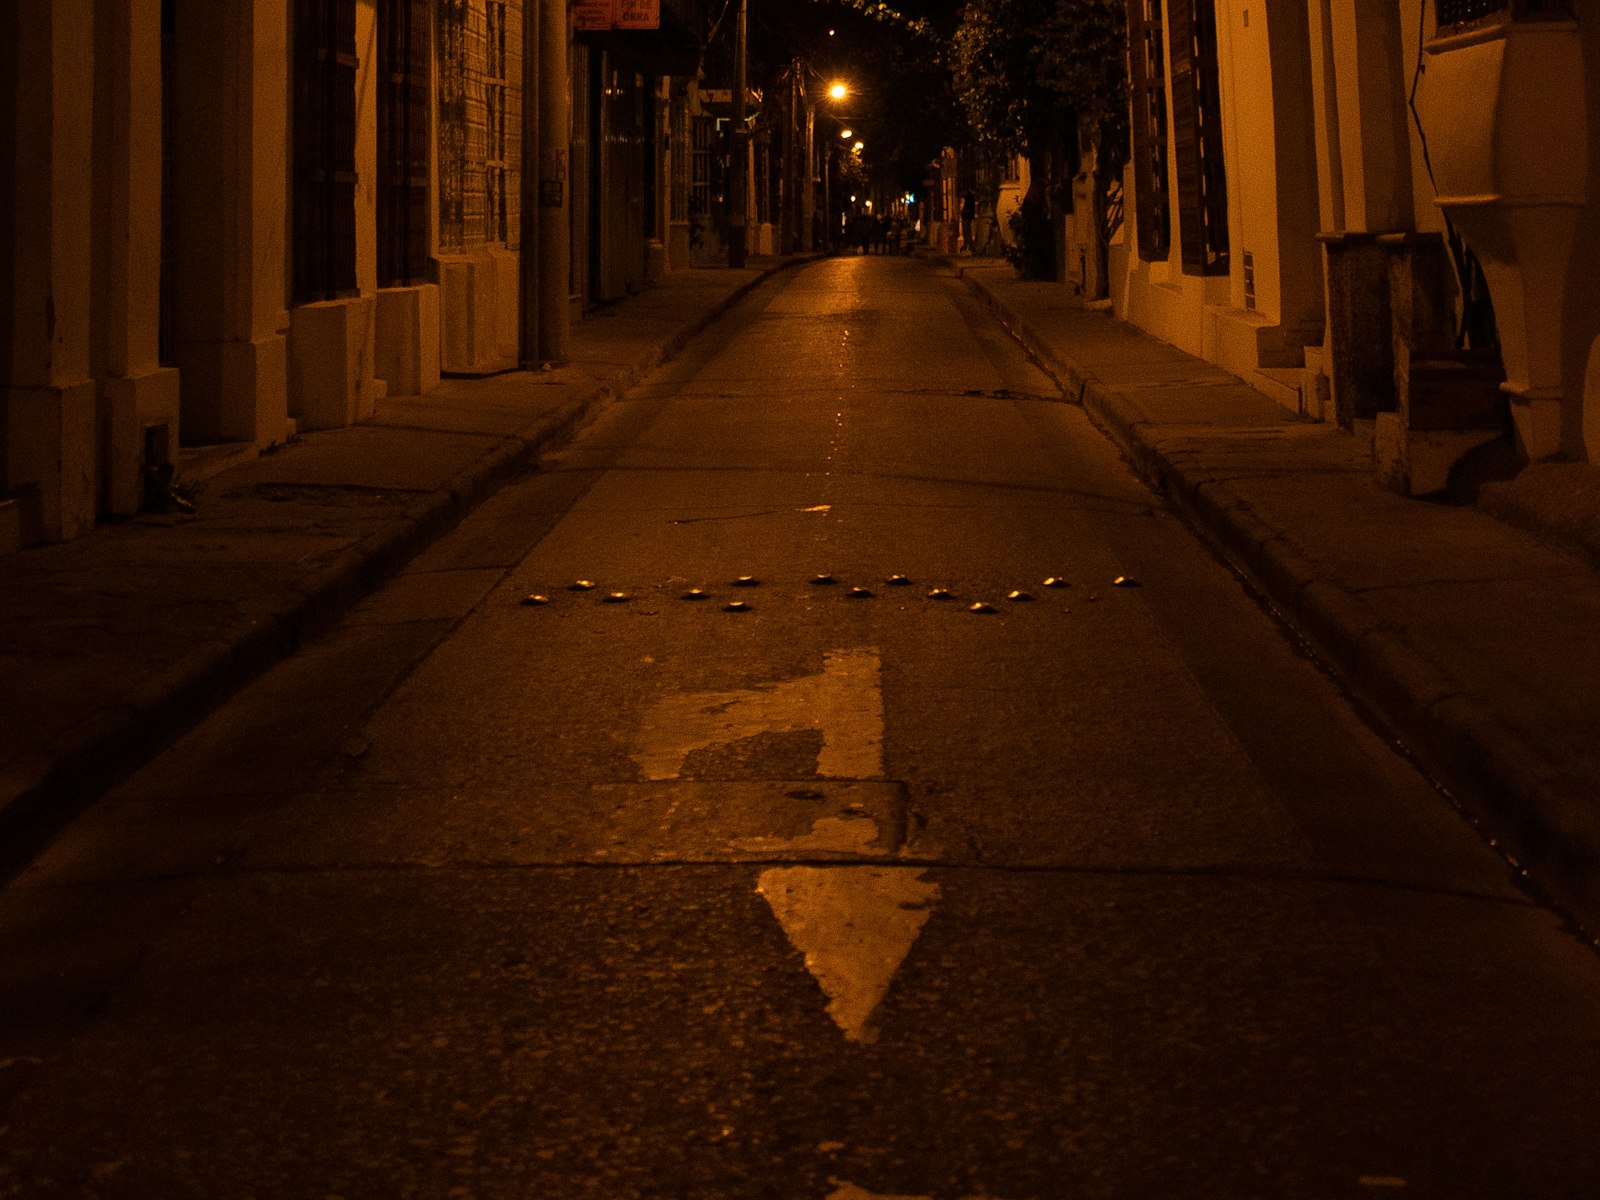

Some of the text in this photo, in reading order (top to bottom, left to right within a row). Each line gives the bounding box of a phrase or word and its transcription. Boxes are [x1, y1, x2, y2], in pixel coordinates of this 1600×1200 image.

[621, 0, 653, 9] FIN DE
[623, 12, 650, 22] OBRA
